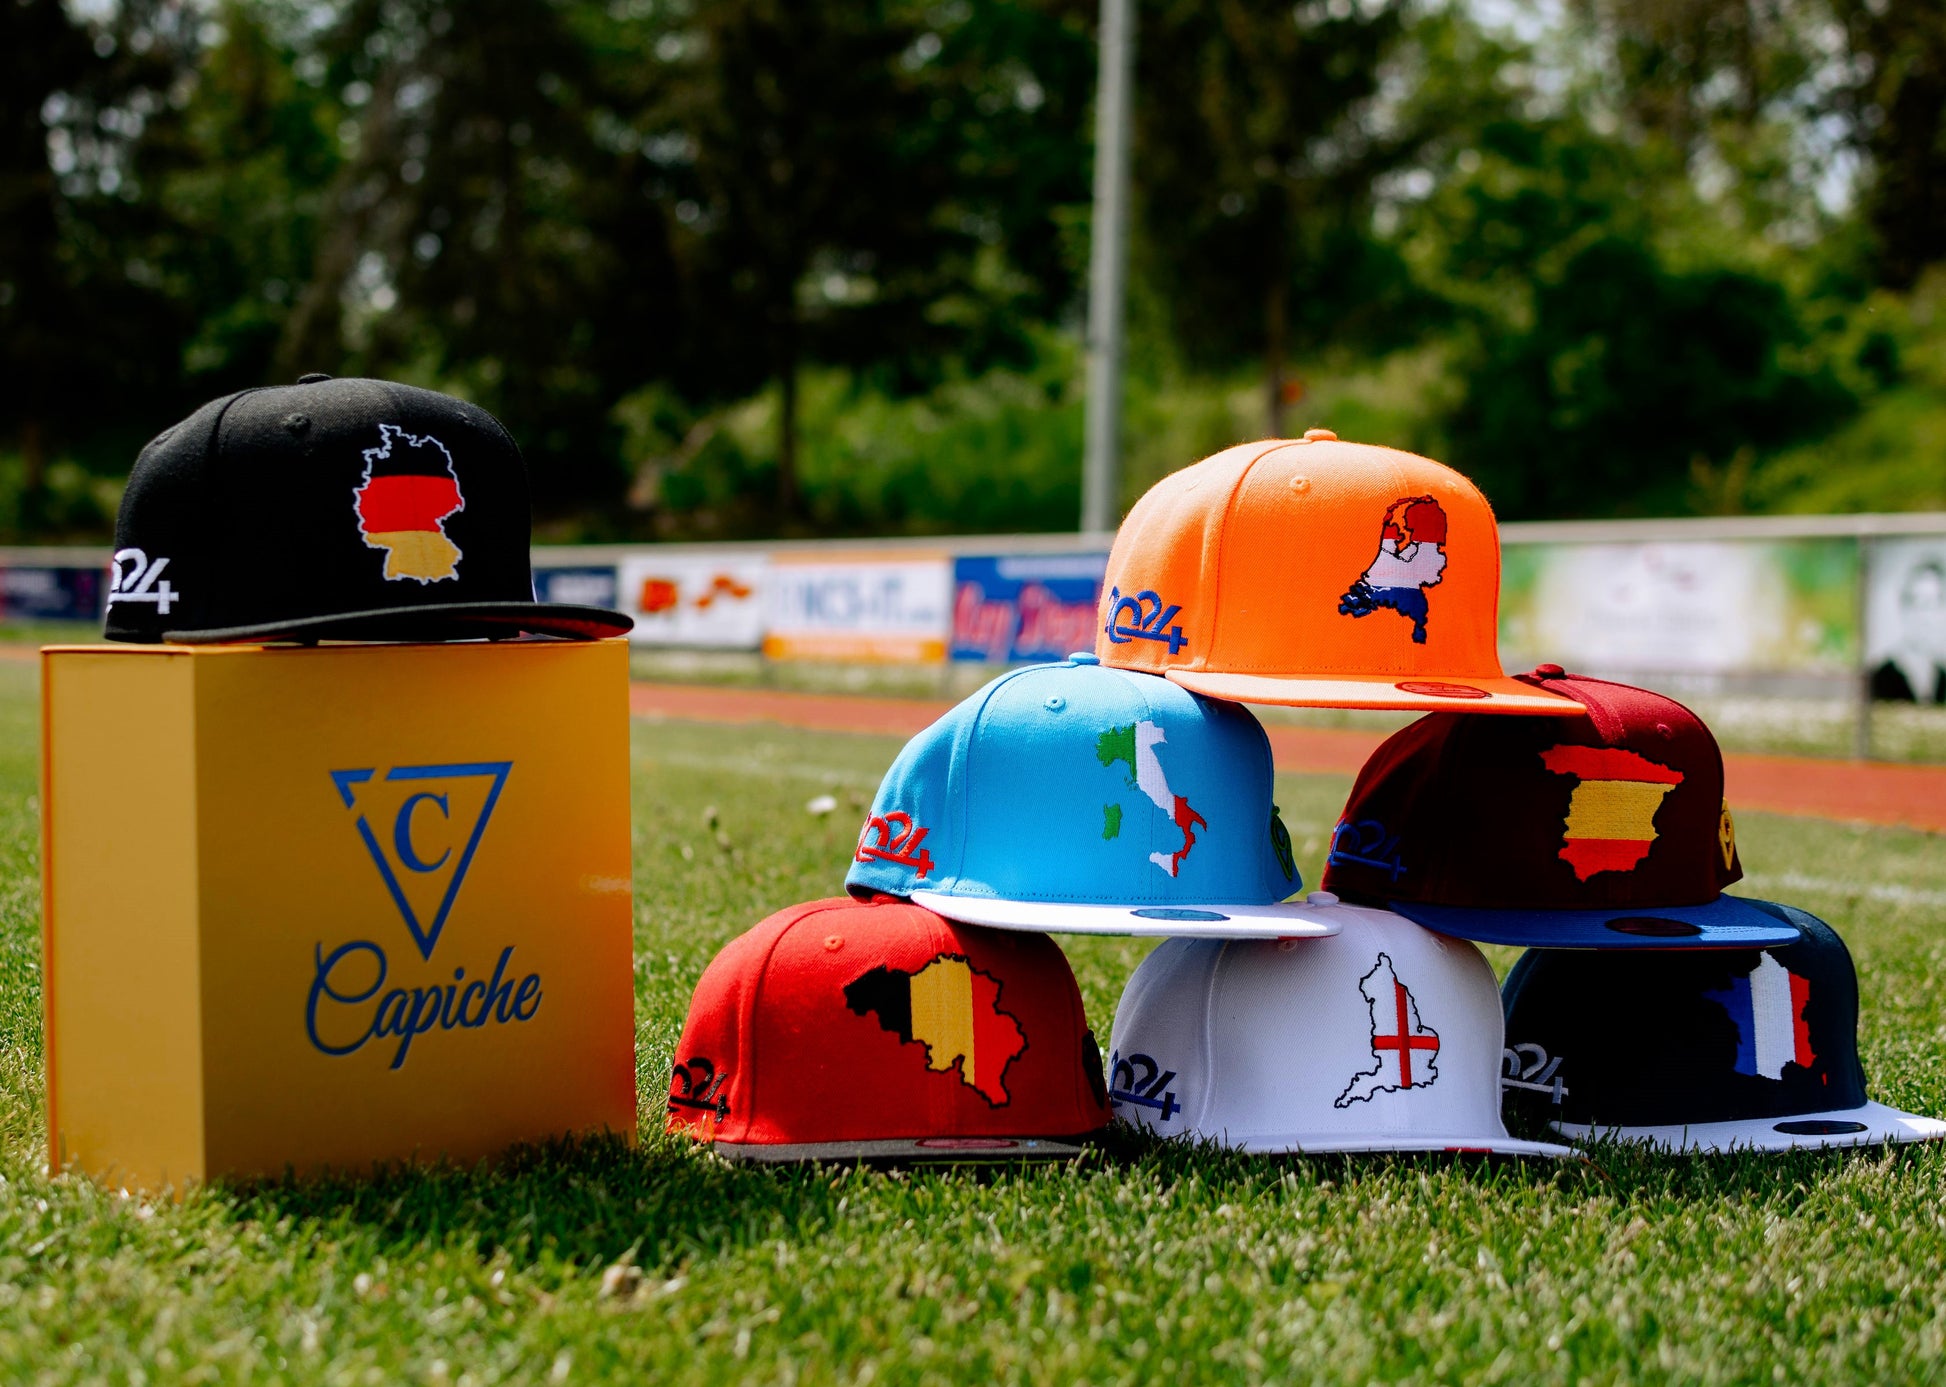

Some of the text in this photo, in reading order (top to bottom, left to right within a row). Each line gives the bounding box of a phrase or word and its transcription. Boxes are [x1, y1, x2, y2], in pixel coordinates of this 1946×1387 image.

[105, 548, 179, 614] 24
[1105, 586, 1188, 655] 2024
[393, 792, 451, 873] C
[855, 811, 934, 879] 024
[1328, 818, 1408, 883] 024
[305, 940, 543, 1072] Capiche
[667, 1057, 731, 1122] 024
[1501, 1043, 1569, 1104] 024
